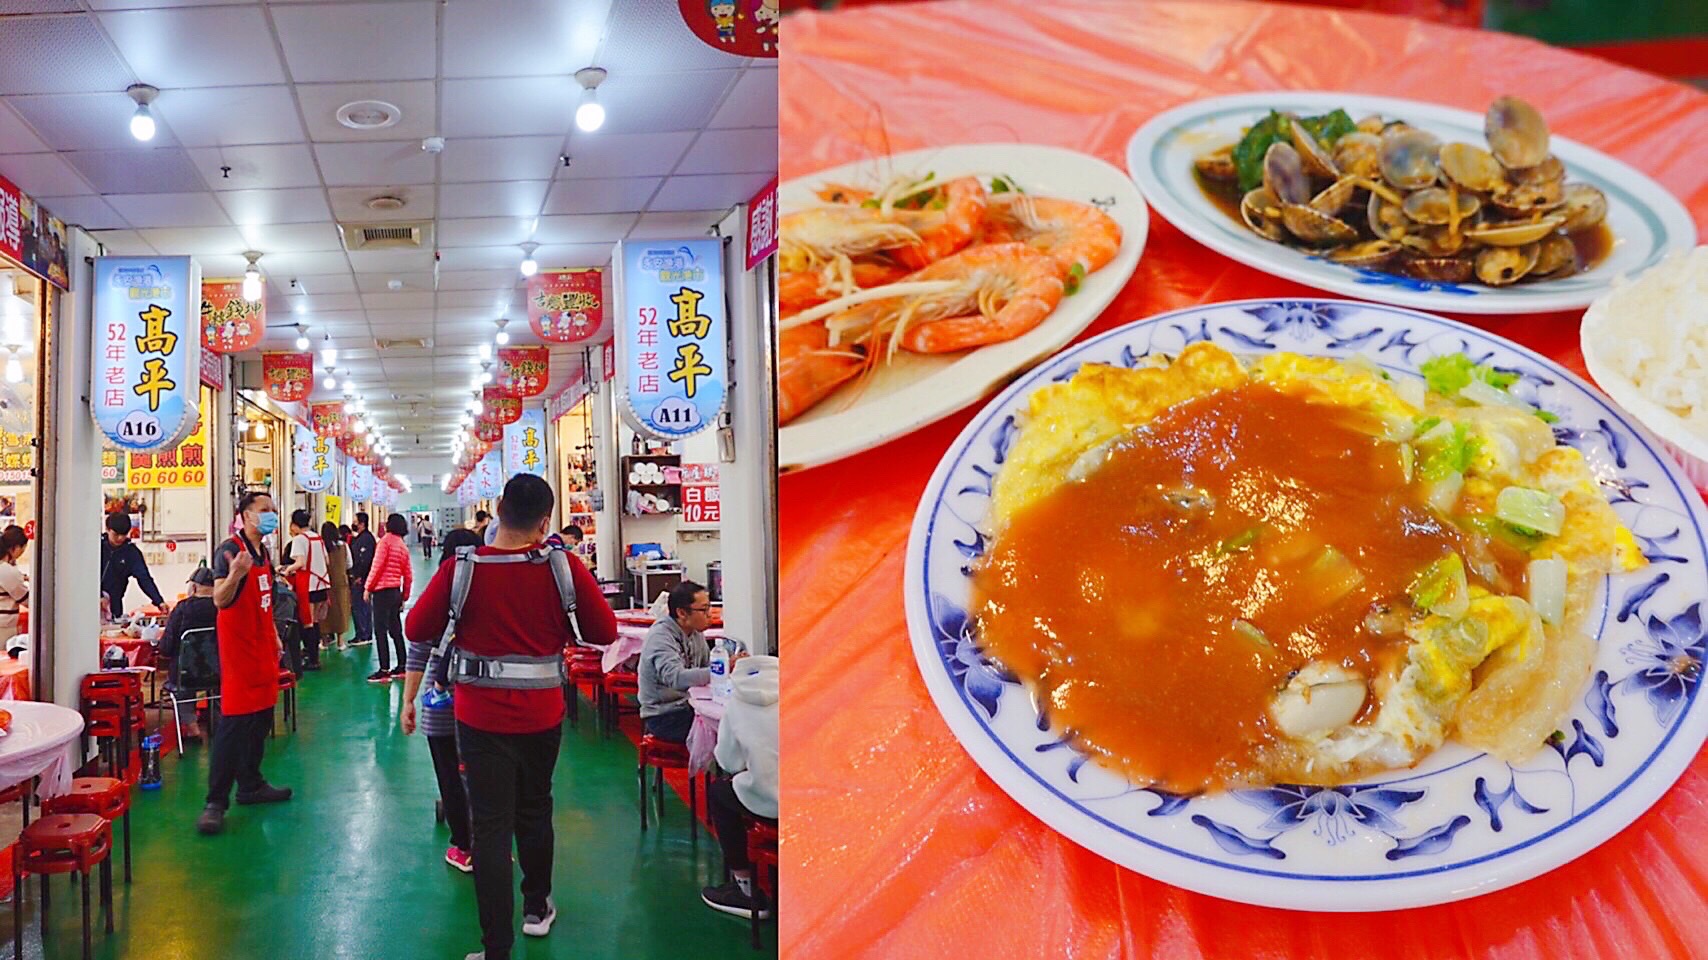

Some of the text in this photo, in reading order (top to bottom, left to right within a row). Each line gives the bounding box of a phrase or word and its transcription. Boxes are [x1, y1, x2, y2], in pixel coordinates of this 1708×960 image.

[750, 189, 778, 258] 感謝
[133, 304, 178, 411] 高平
[667, 287, 712, 398] 高平
[123, 421, 157, 437] A16
[659, 408, 692, 423] A11
[131, 470, 204, 485] 60 60 60
